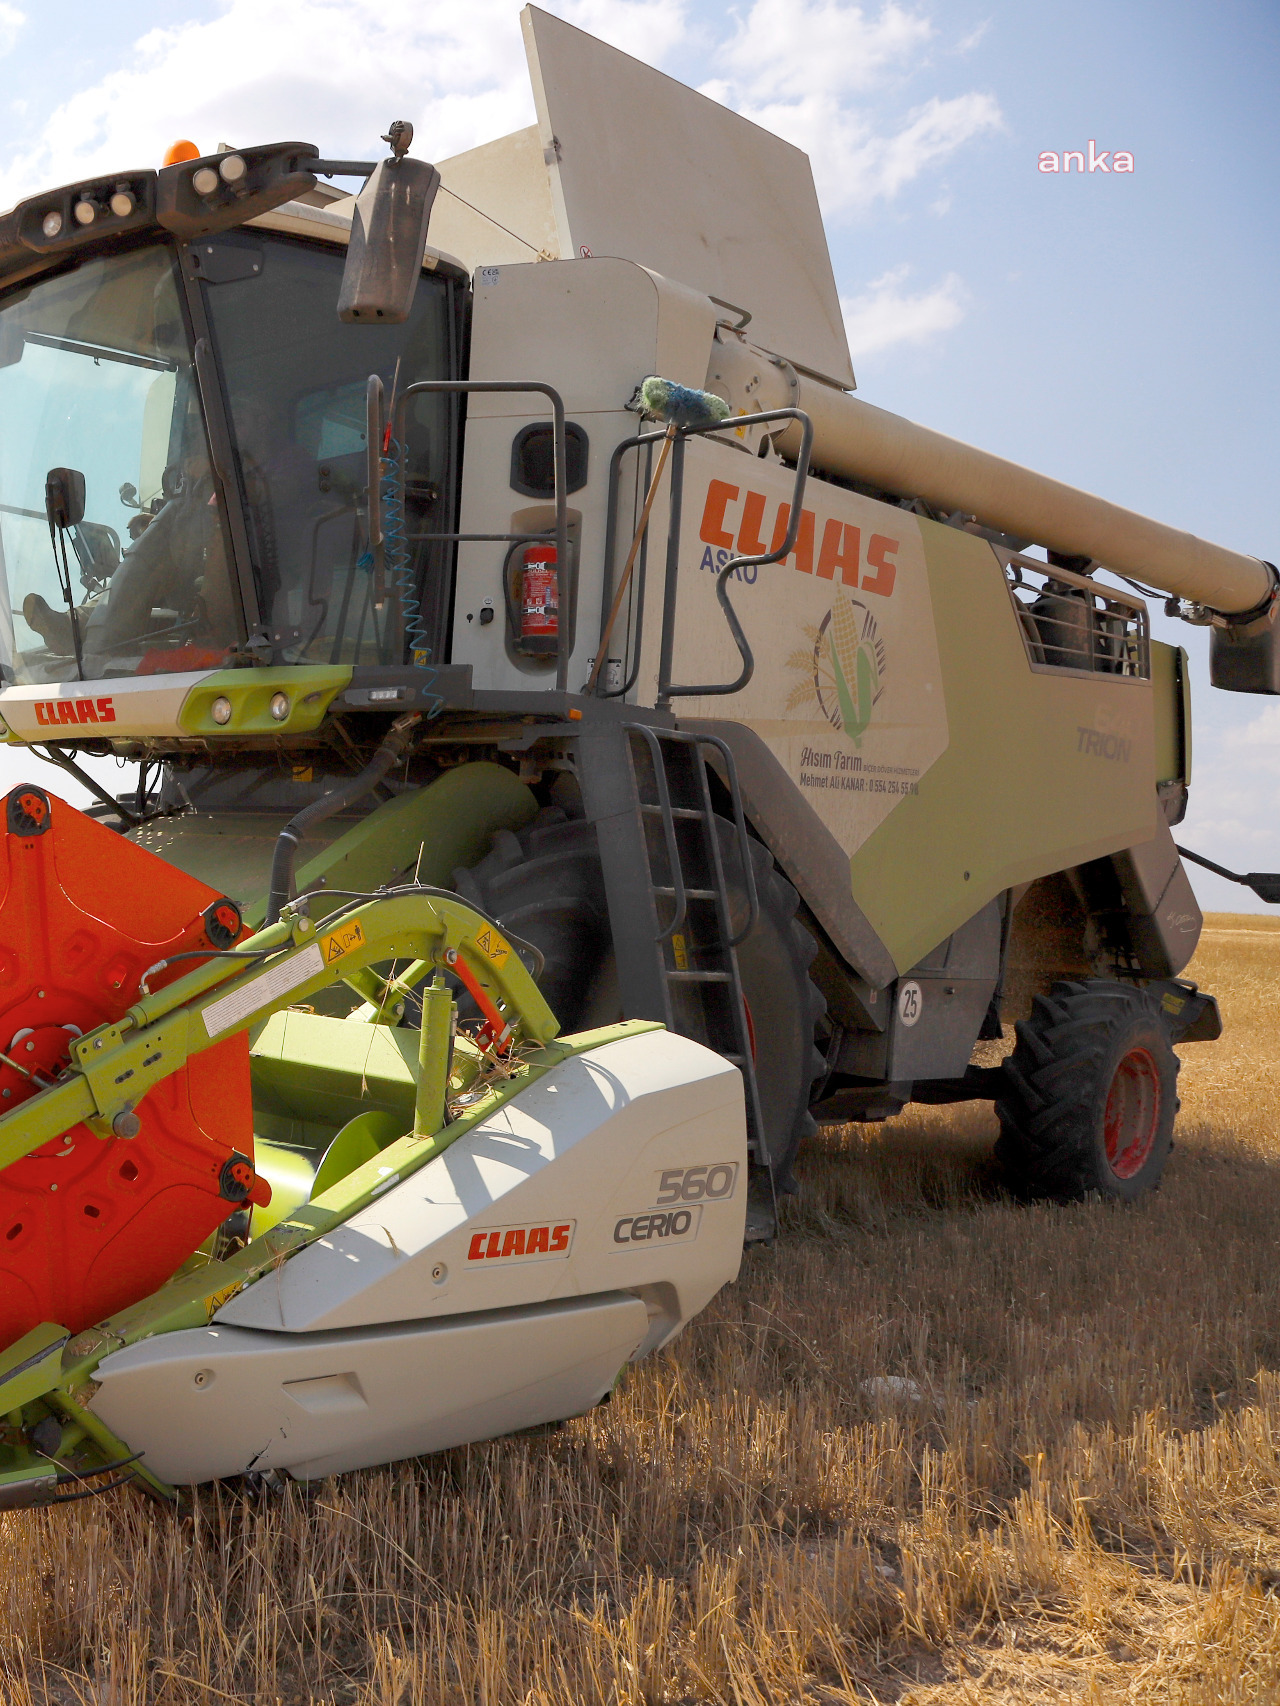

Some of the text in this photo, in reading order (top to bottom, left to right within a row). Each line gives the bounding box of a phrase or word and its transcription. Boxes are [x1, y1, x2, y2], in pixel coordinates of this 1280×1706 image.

[699, 478, 900, 598] CLAAS
[34, 697, 116, 725] CLAAS
[1077, 726, 1132, 763] TRION
[800, 773, 828, 789] Mehmet
[829, 775, 840, 790] Ali
[840, 776, 865, 792] KANAR
[869, 779, 874, 792] 0
[875, 780, 887, 793] 554
[902, 989, 918, 1018] 25
[656, 1165, 733, 1205] 560
[468, 1224, 570, 1260] CLAAS
[613, 1210, 692, 1243] CERIO
